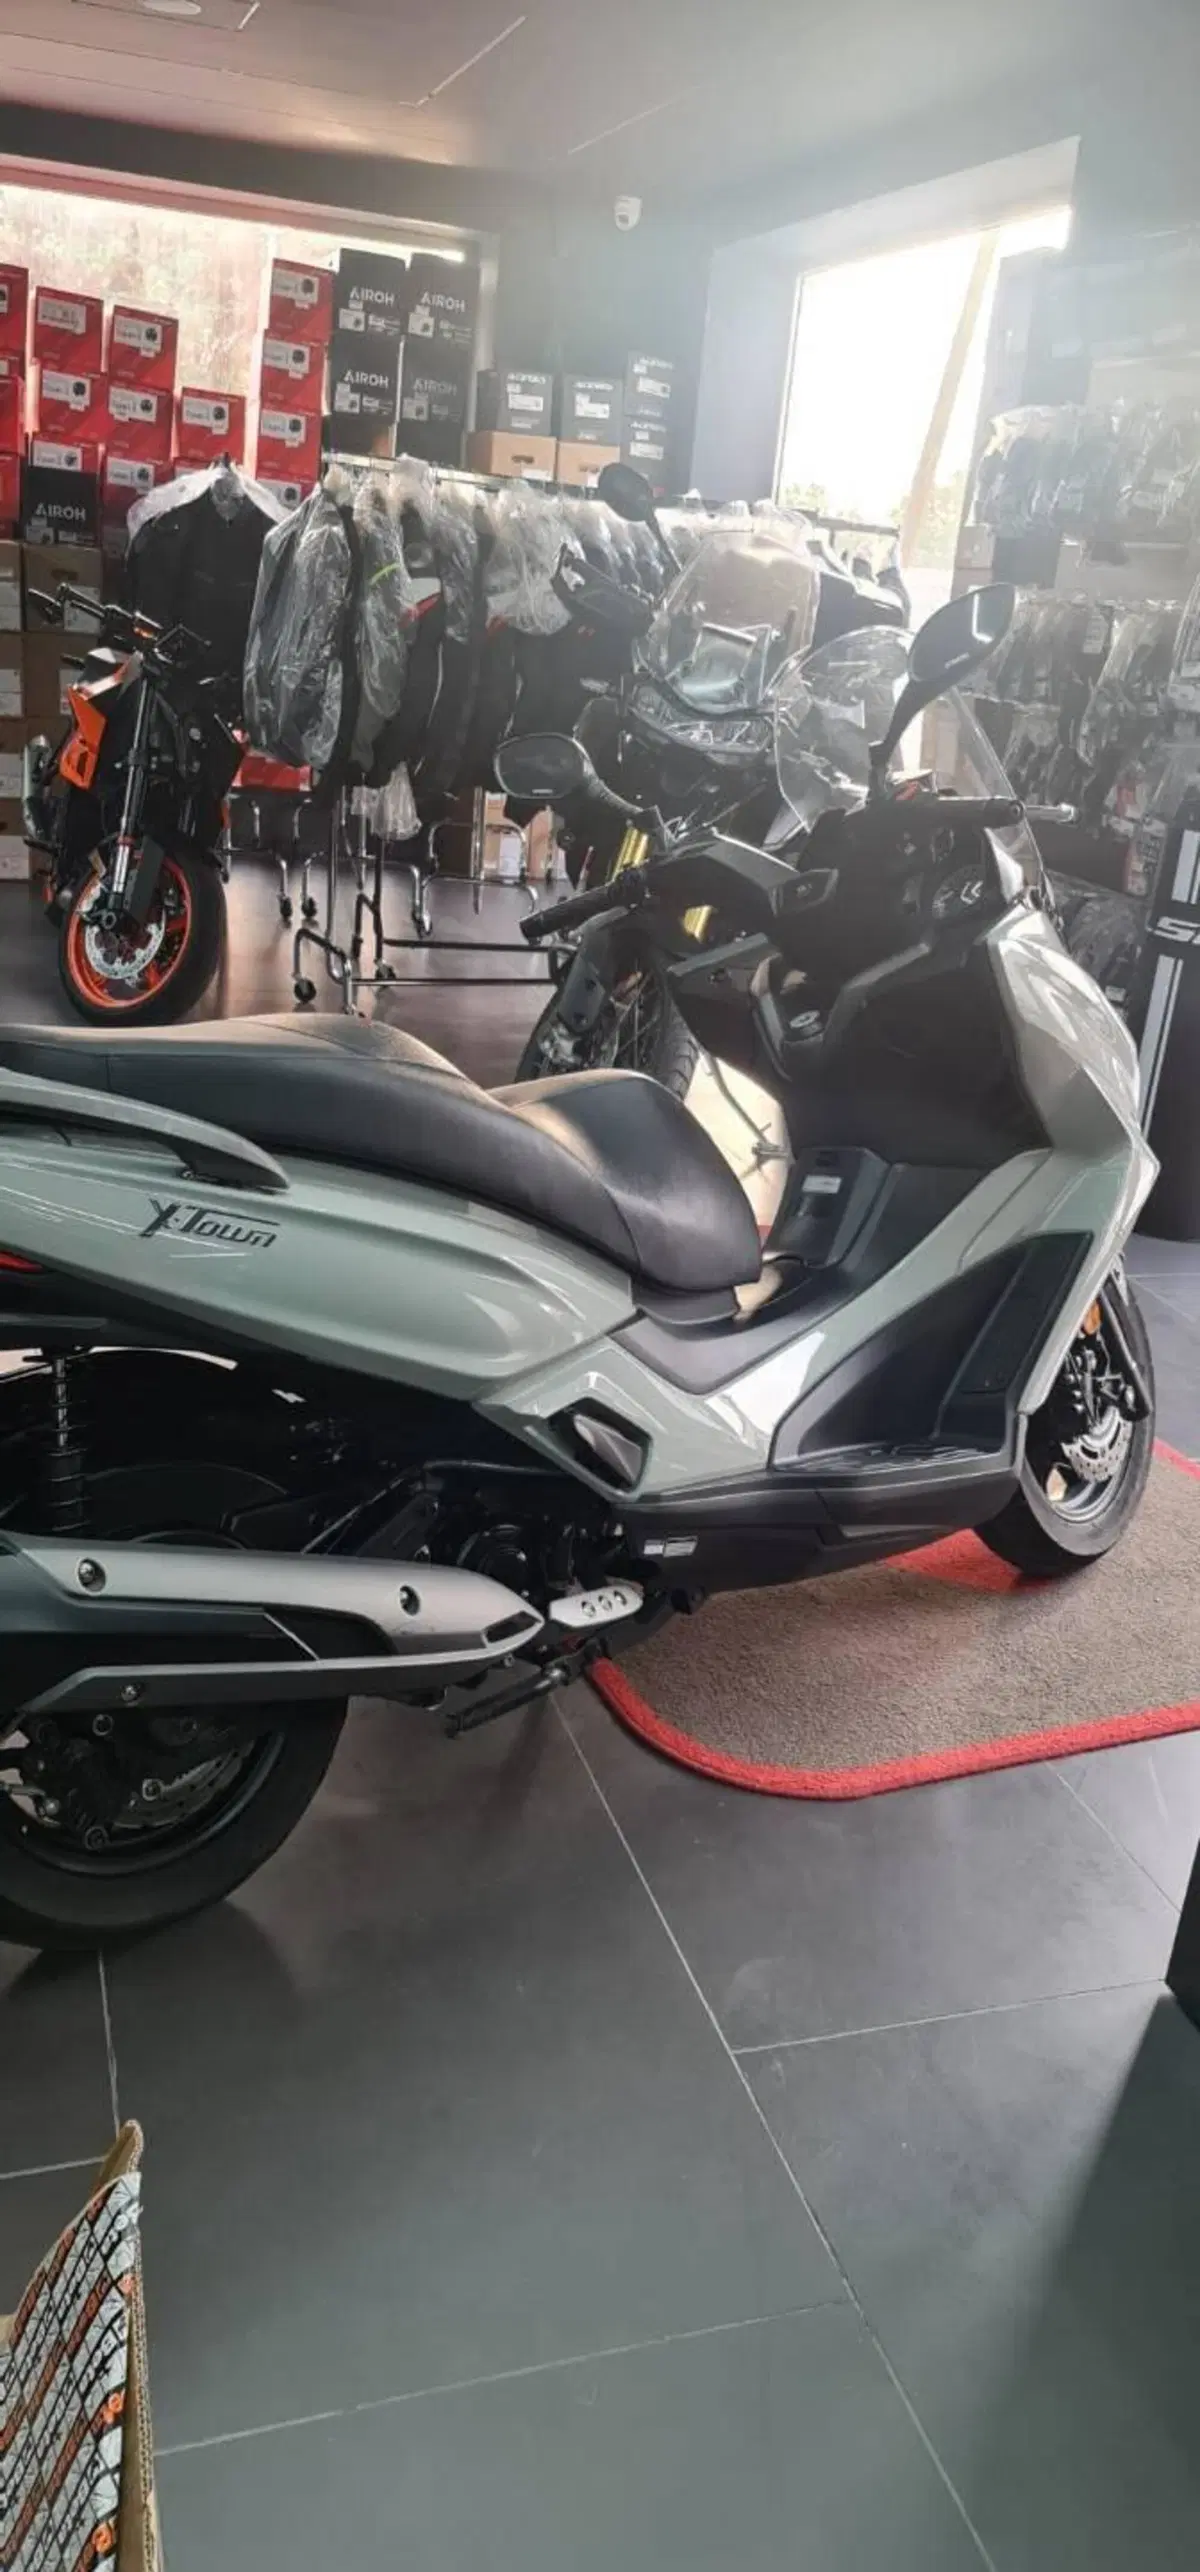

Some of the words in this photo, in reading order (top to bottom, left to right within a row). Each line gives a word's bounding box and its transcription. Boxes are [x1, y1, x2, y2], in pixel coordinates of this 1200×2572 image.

[350, 287, 395, 306] AIROH
[421, 291, 466, 313] AIROH
[343, 369, 389, 389] AIROH
[413, 377, 458, 396] AIROH
[35, 502, 86, 521] AIROH
